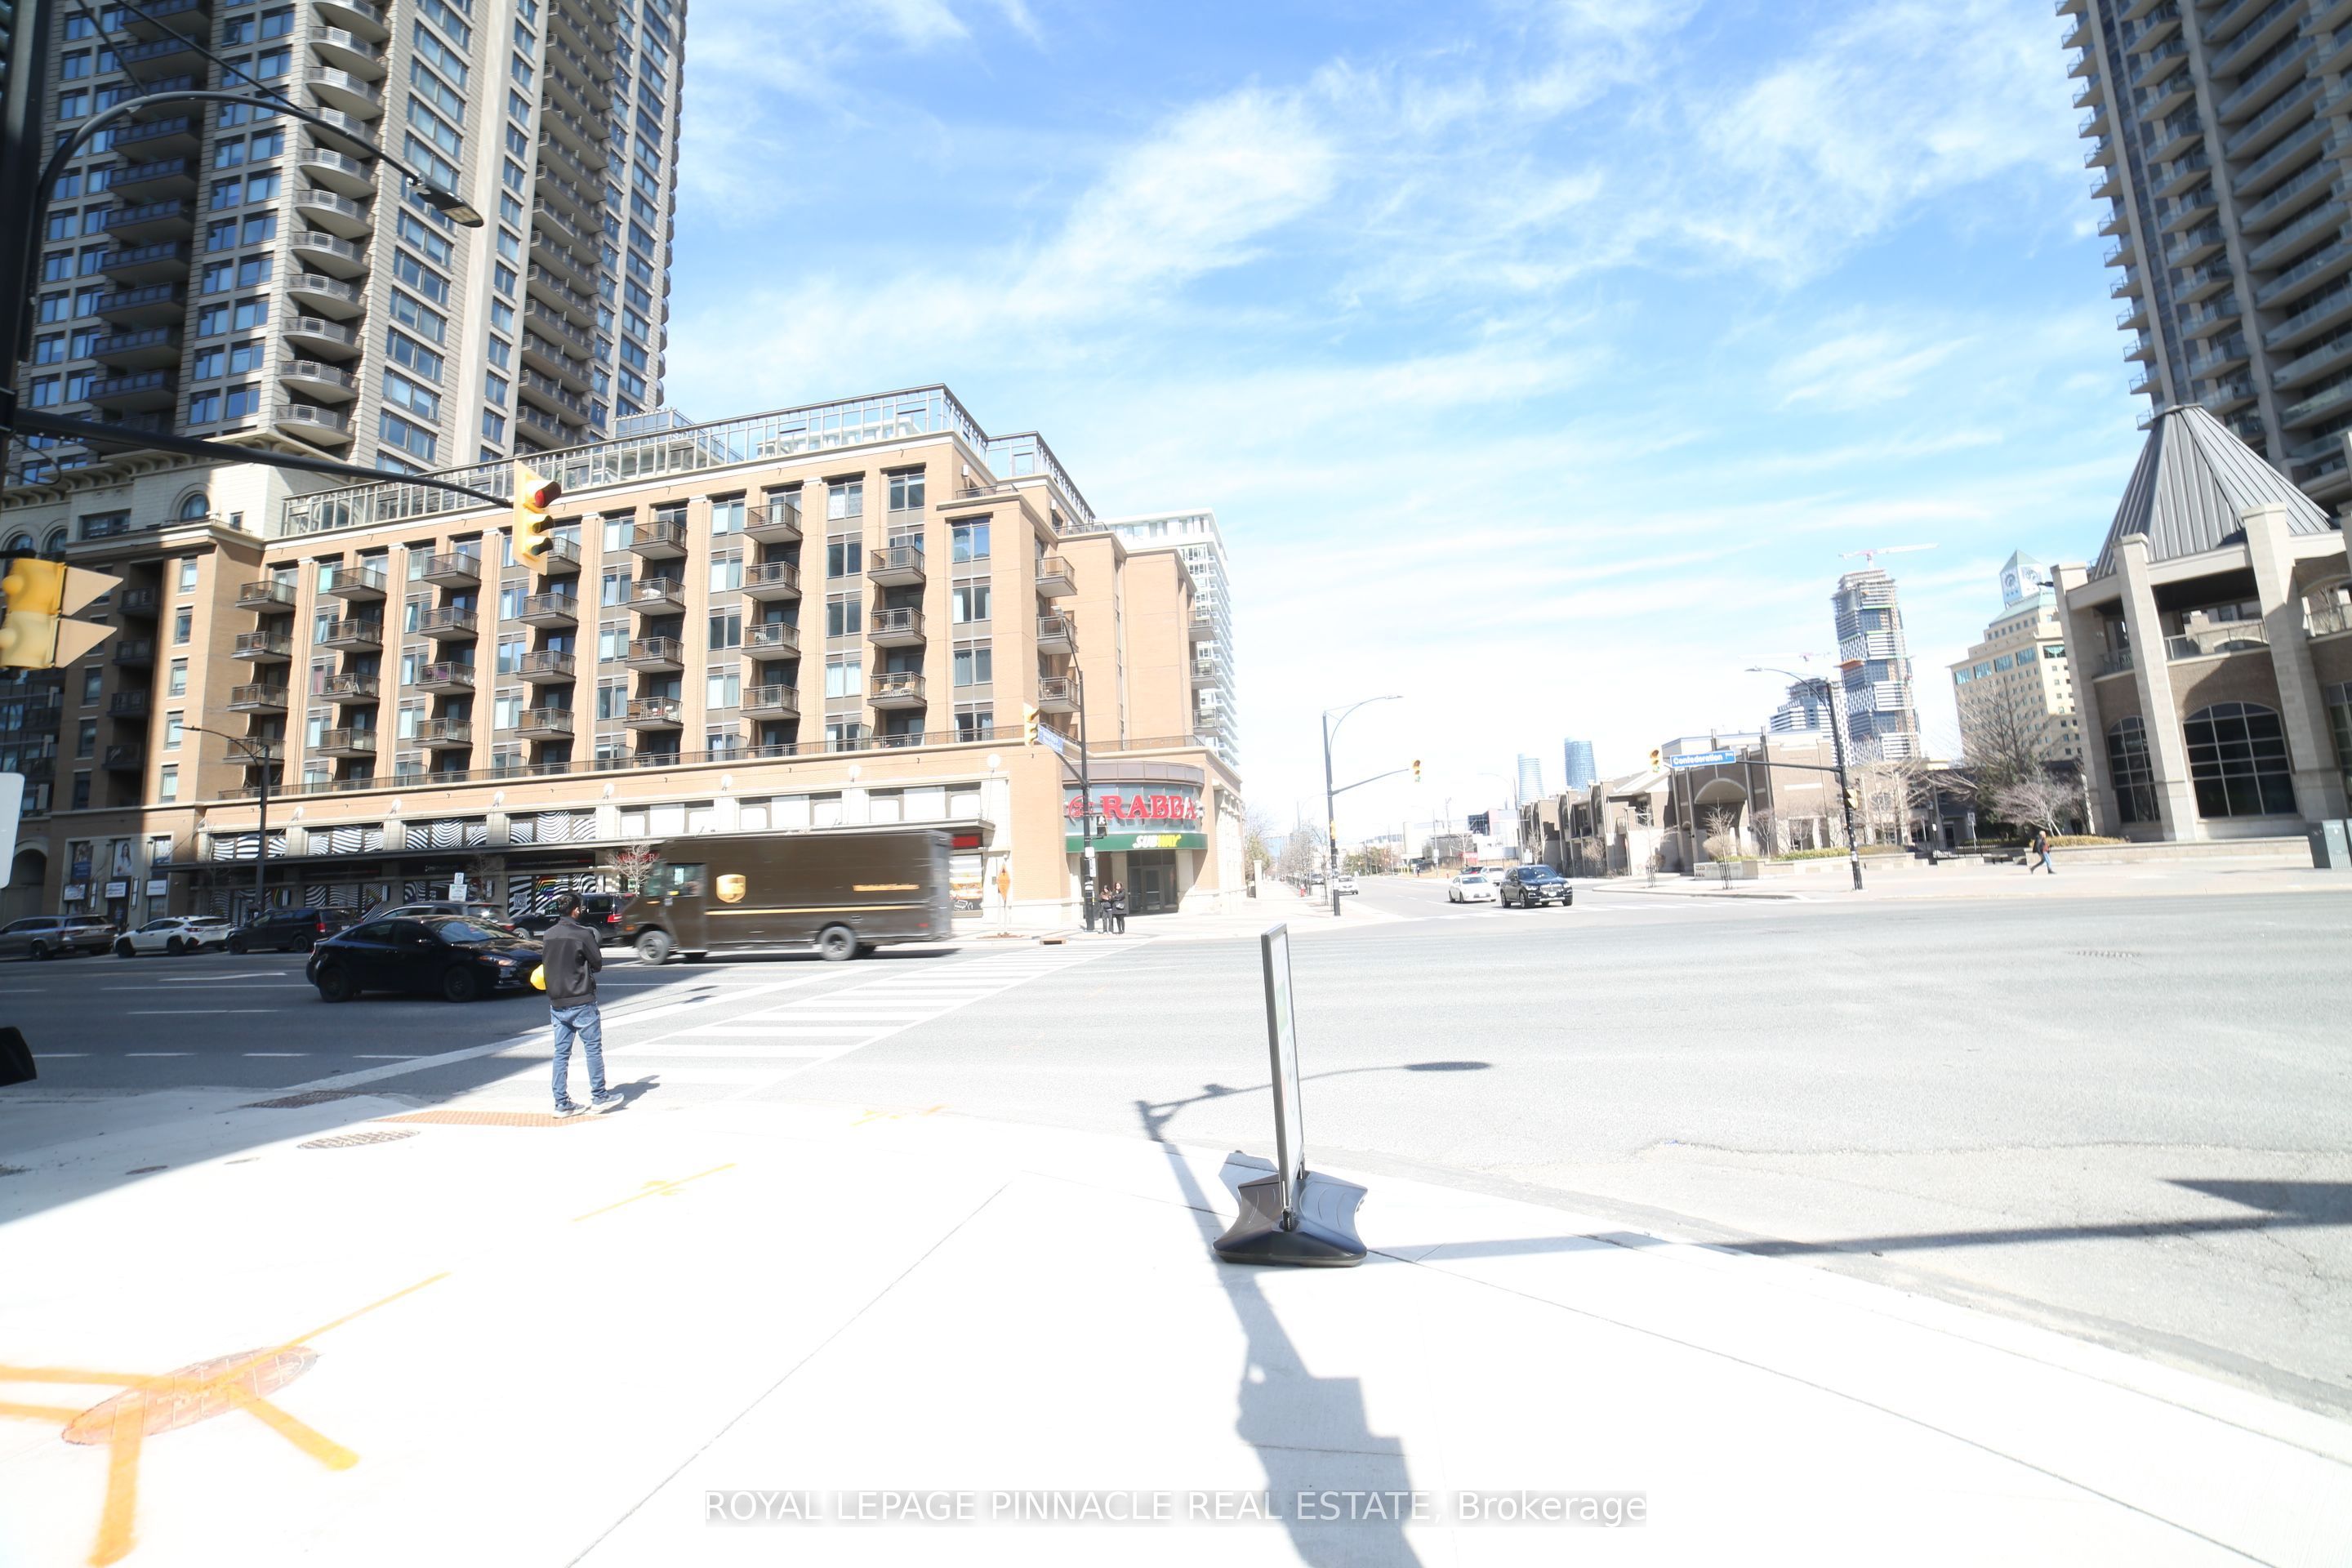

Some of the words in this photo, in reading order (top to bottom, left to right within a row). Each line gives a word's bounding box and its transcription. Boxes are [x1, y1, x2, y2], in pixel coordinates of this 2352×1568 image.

[1673, 753, 1723, 764] Confederation
[1100, 795, 1196, 820] RABBA
[1132, 835, 1182, 849] SUBWAY
